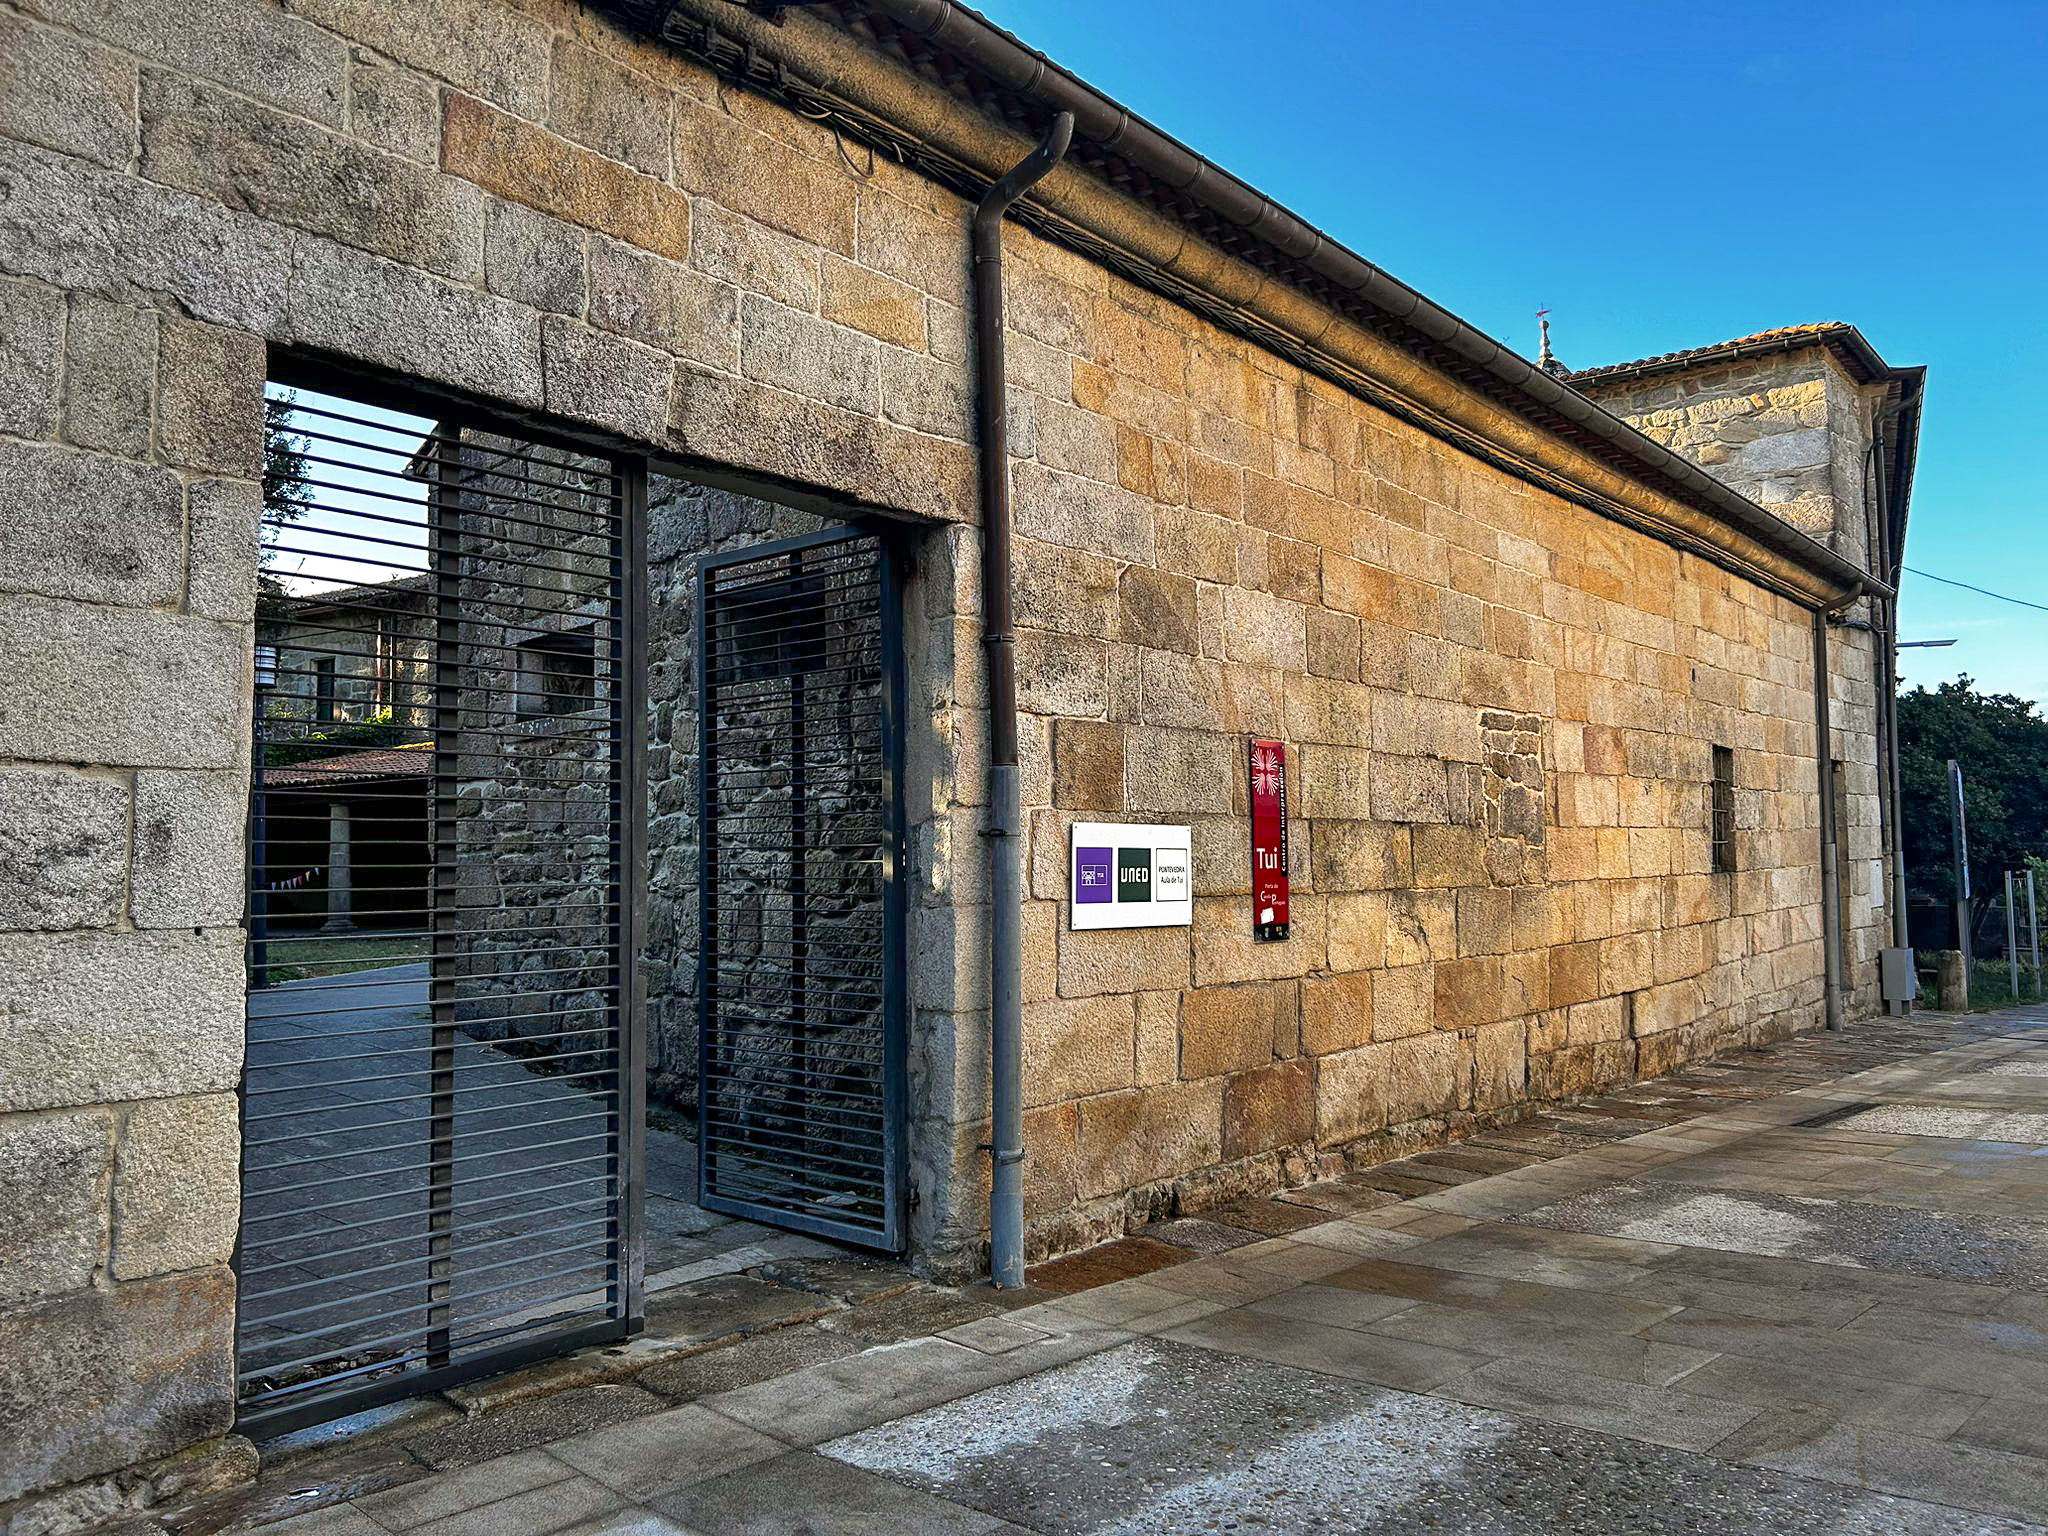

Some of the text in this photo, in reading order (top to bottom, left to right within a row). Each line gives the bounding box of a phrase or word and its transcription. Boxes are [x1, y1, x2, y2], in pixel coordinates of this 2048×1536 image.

[1280, 829, 1286, 841] de
[1256, 847, 1278, 869] Tui
[1120, 867, 1149, 883] UNED
